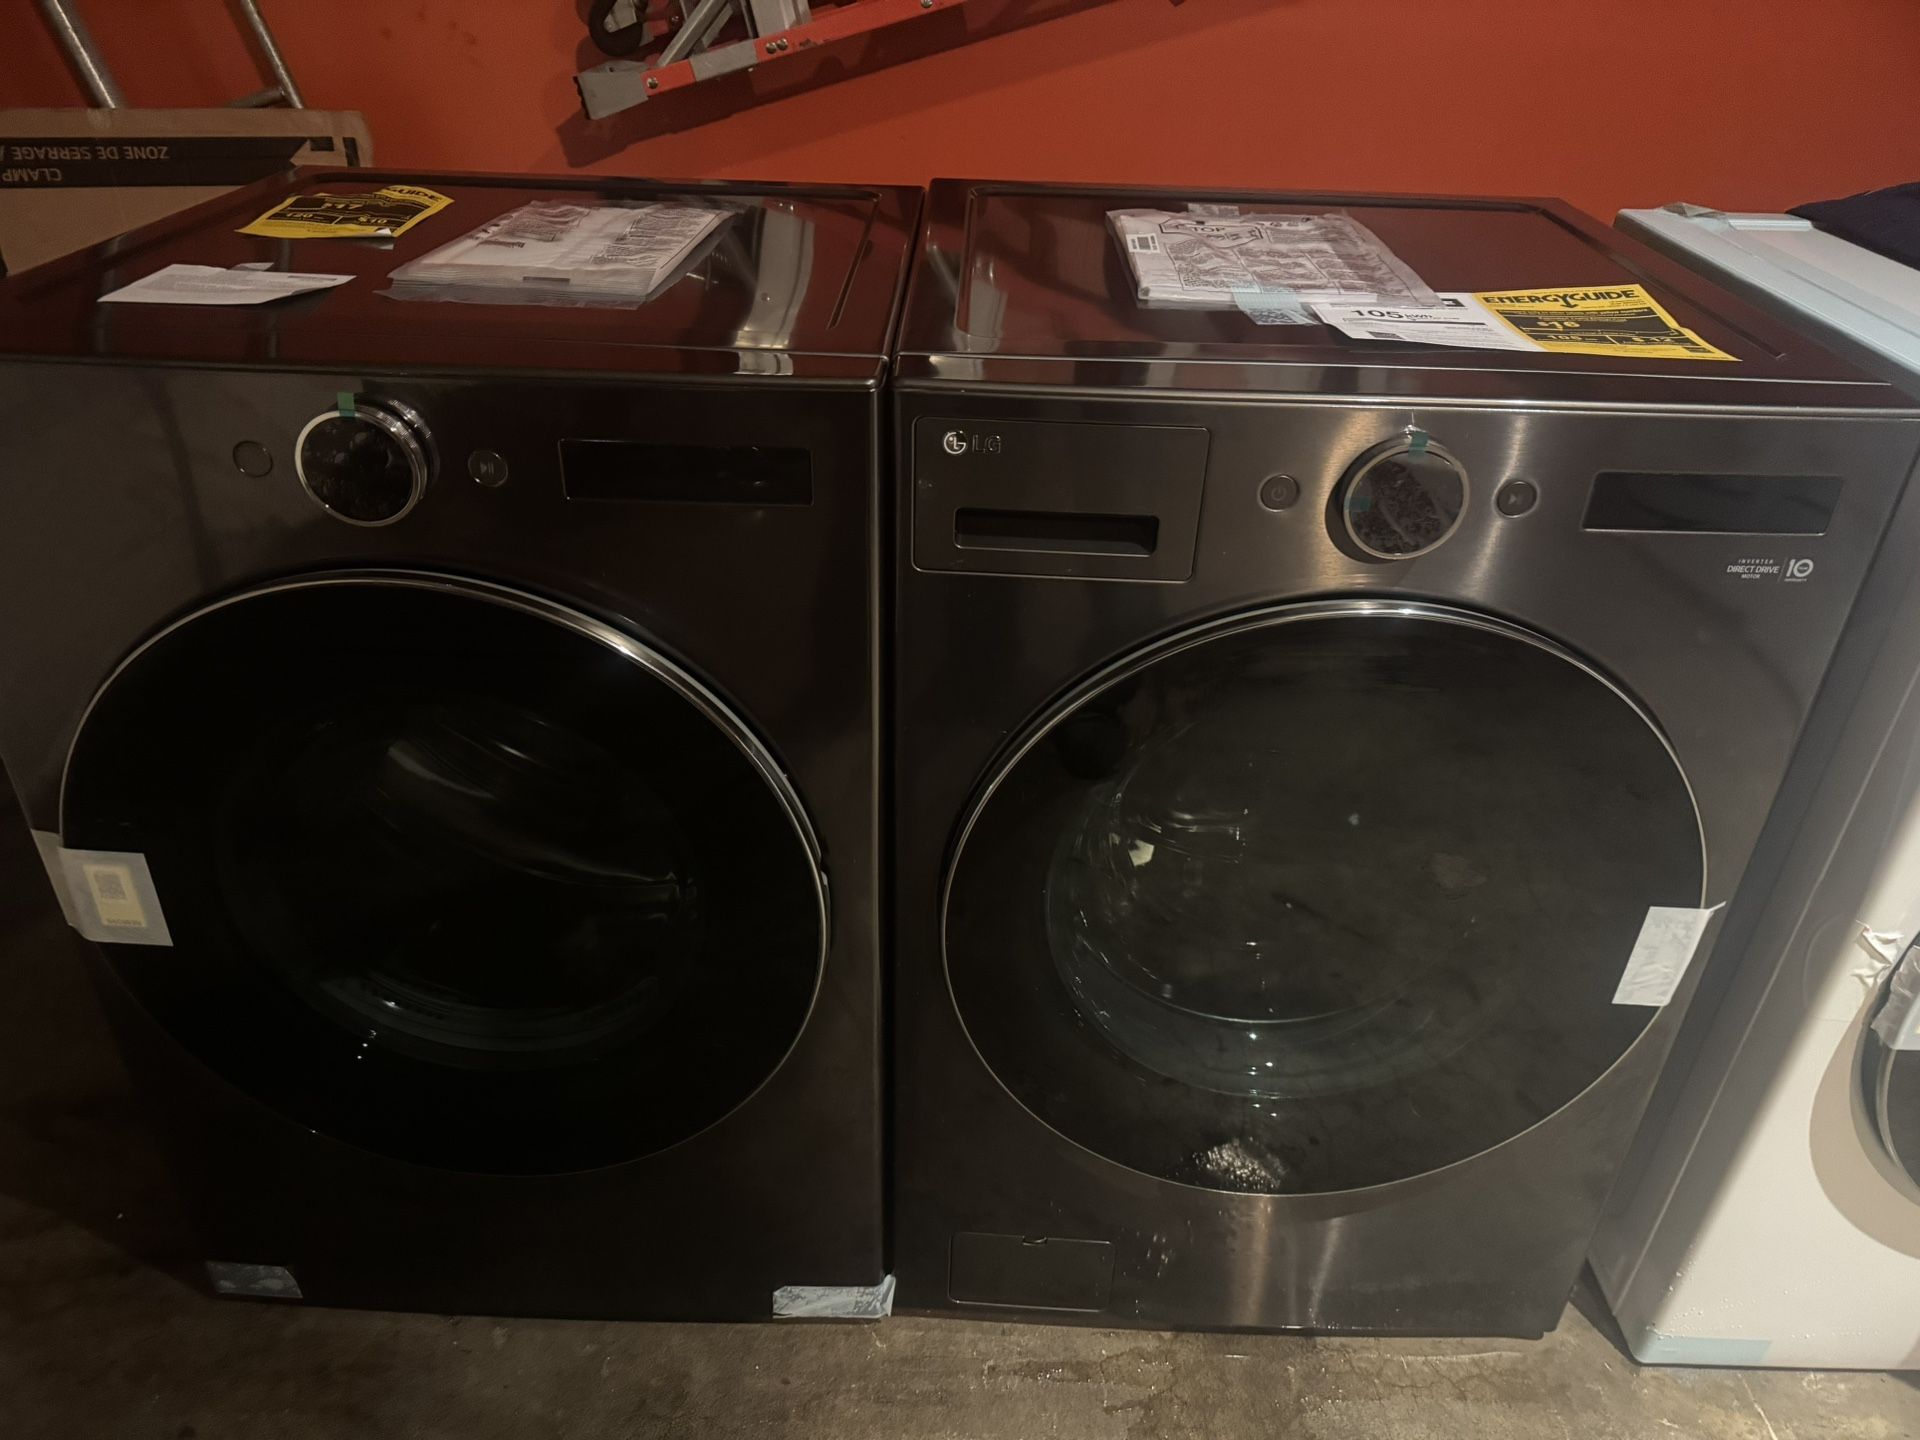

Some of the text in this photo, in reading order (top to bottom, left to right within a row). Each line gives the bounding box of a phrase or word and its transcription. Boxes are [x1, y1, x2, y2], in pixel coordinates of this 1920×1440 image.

[10, 145, 91, 160] SERRAGE
[96, 146, 119, 160] DE
[123, 145, 170, 160] ZONE
[1, 167, 63, 182] CLAMP
[1481, 289, 1640, 309] ENERGYGUIDE
[1350, 309, 1405, 319] 105
[972, 433, 1002, 454] LG
[1726, 565, 1781, 574] DIRECT DRIVE
[1786, 558, 1814, 577] 10
